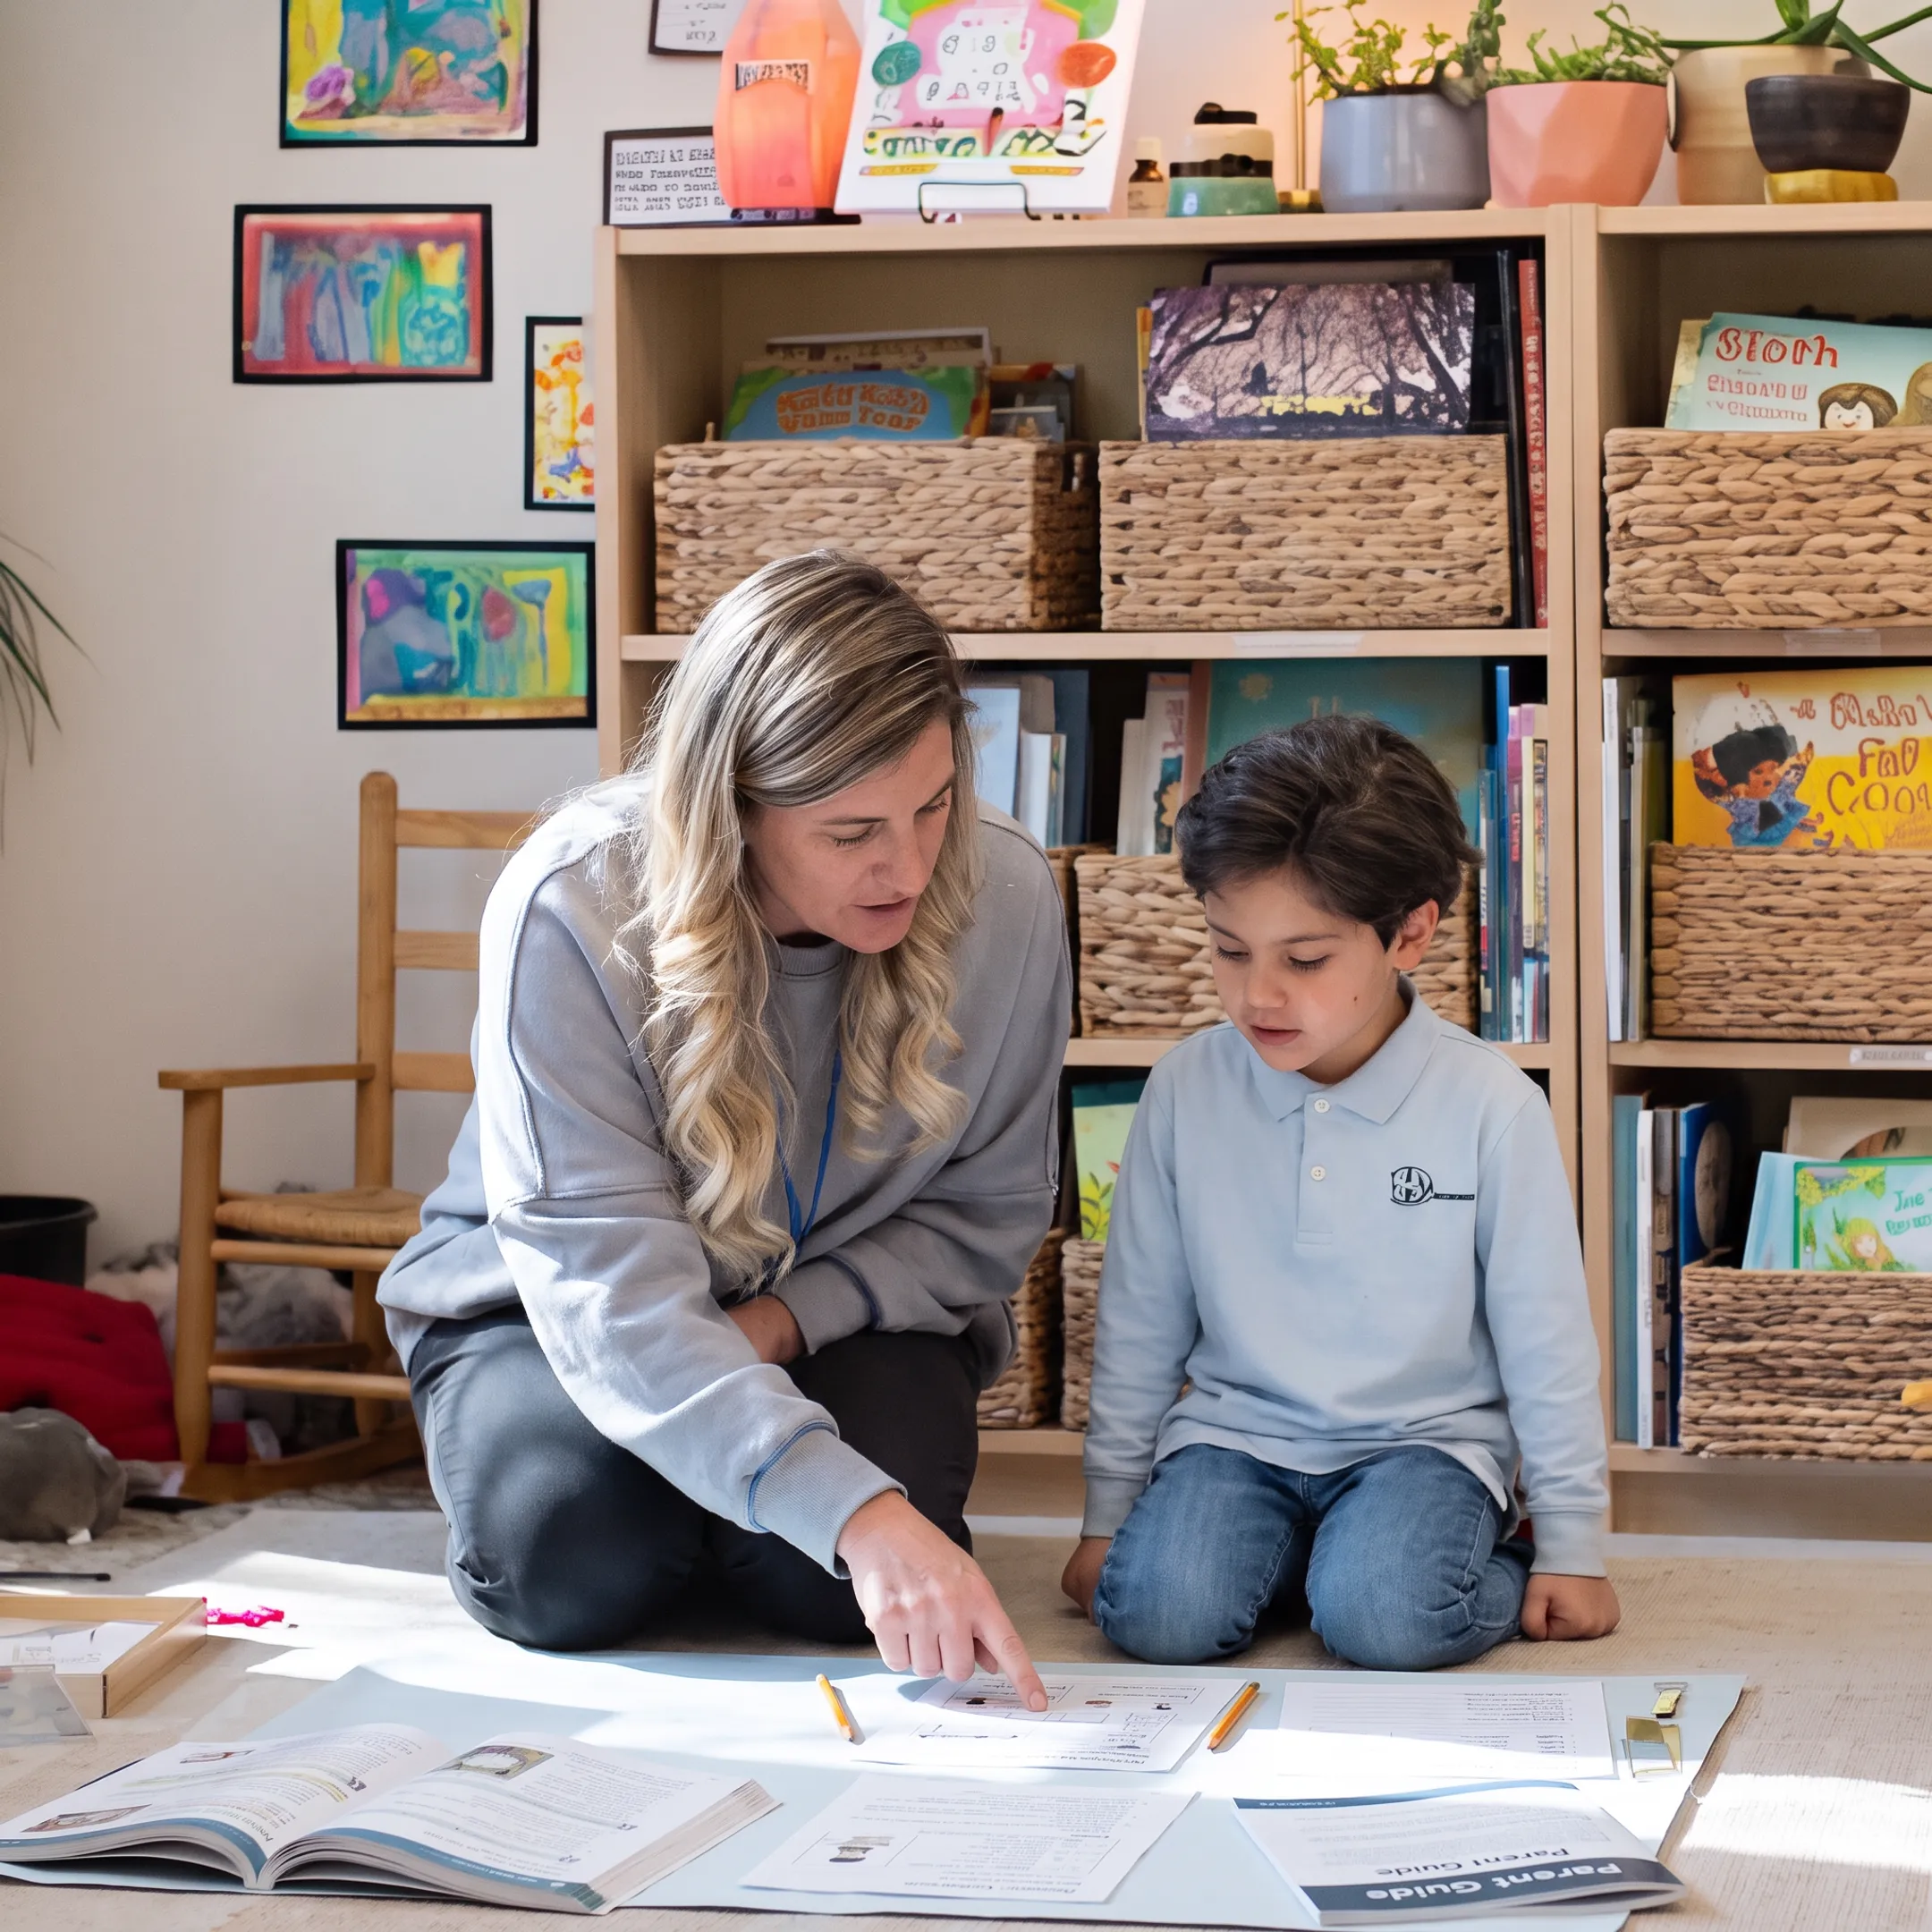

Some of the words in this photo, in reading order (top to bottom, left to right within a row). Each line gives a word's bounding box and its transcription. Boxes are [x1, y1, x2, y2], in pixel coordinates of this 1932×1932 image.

[1474, 1848, 1570, 1866] Parent
[1376, 1861, 1464, 1876] Guide
[1492, 1862, 1623, 1888] Parent
[1366, 1881, 1484, 1901] Guide
